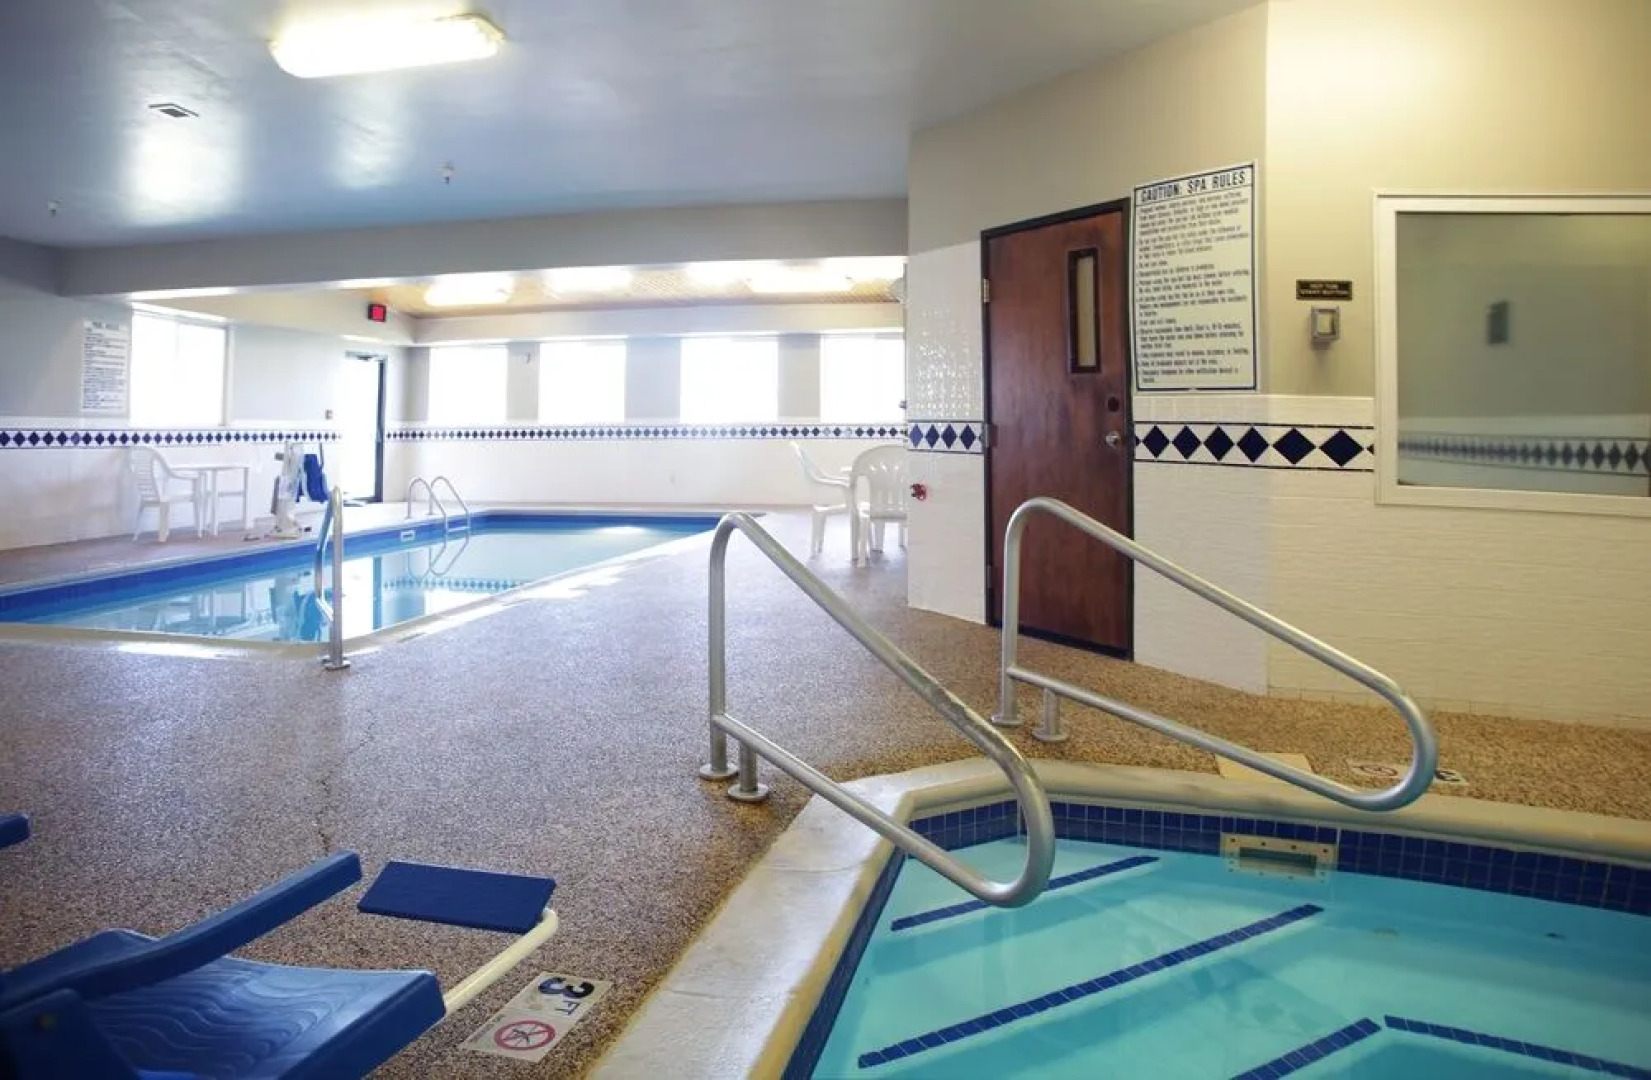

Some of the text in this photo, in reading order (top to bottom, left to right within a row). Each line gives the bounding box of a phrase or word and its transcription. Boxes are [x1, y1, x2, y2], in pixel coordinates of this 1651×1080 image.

[1141, 171, 1245, 202] CAUTION: SPA RULES
[538, 977, 595, 1016] 3 FT
